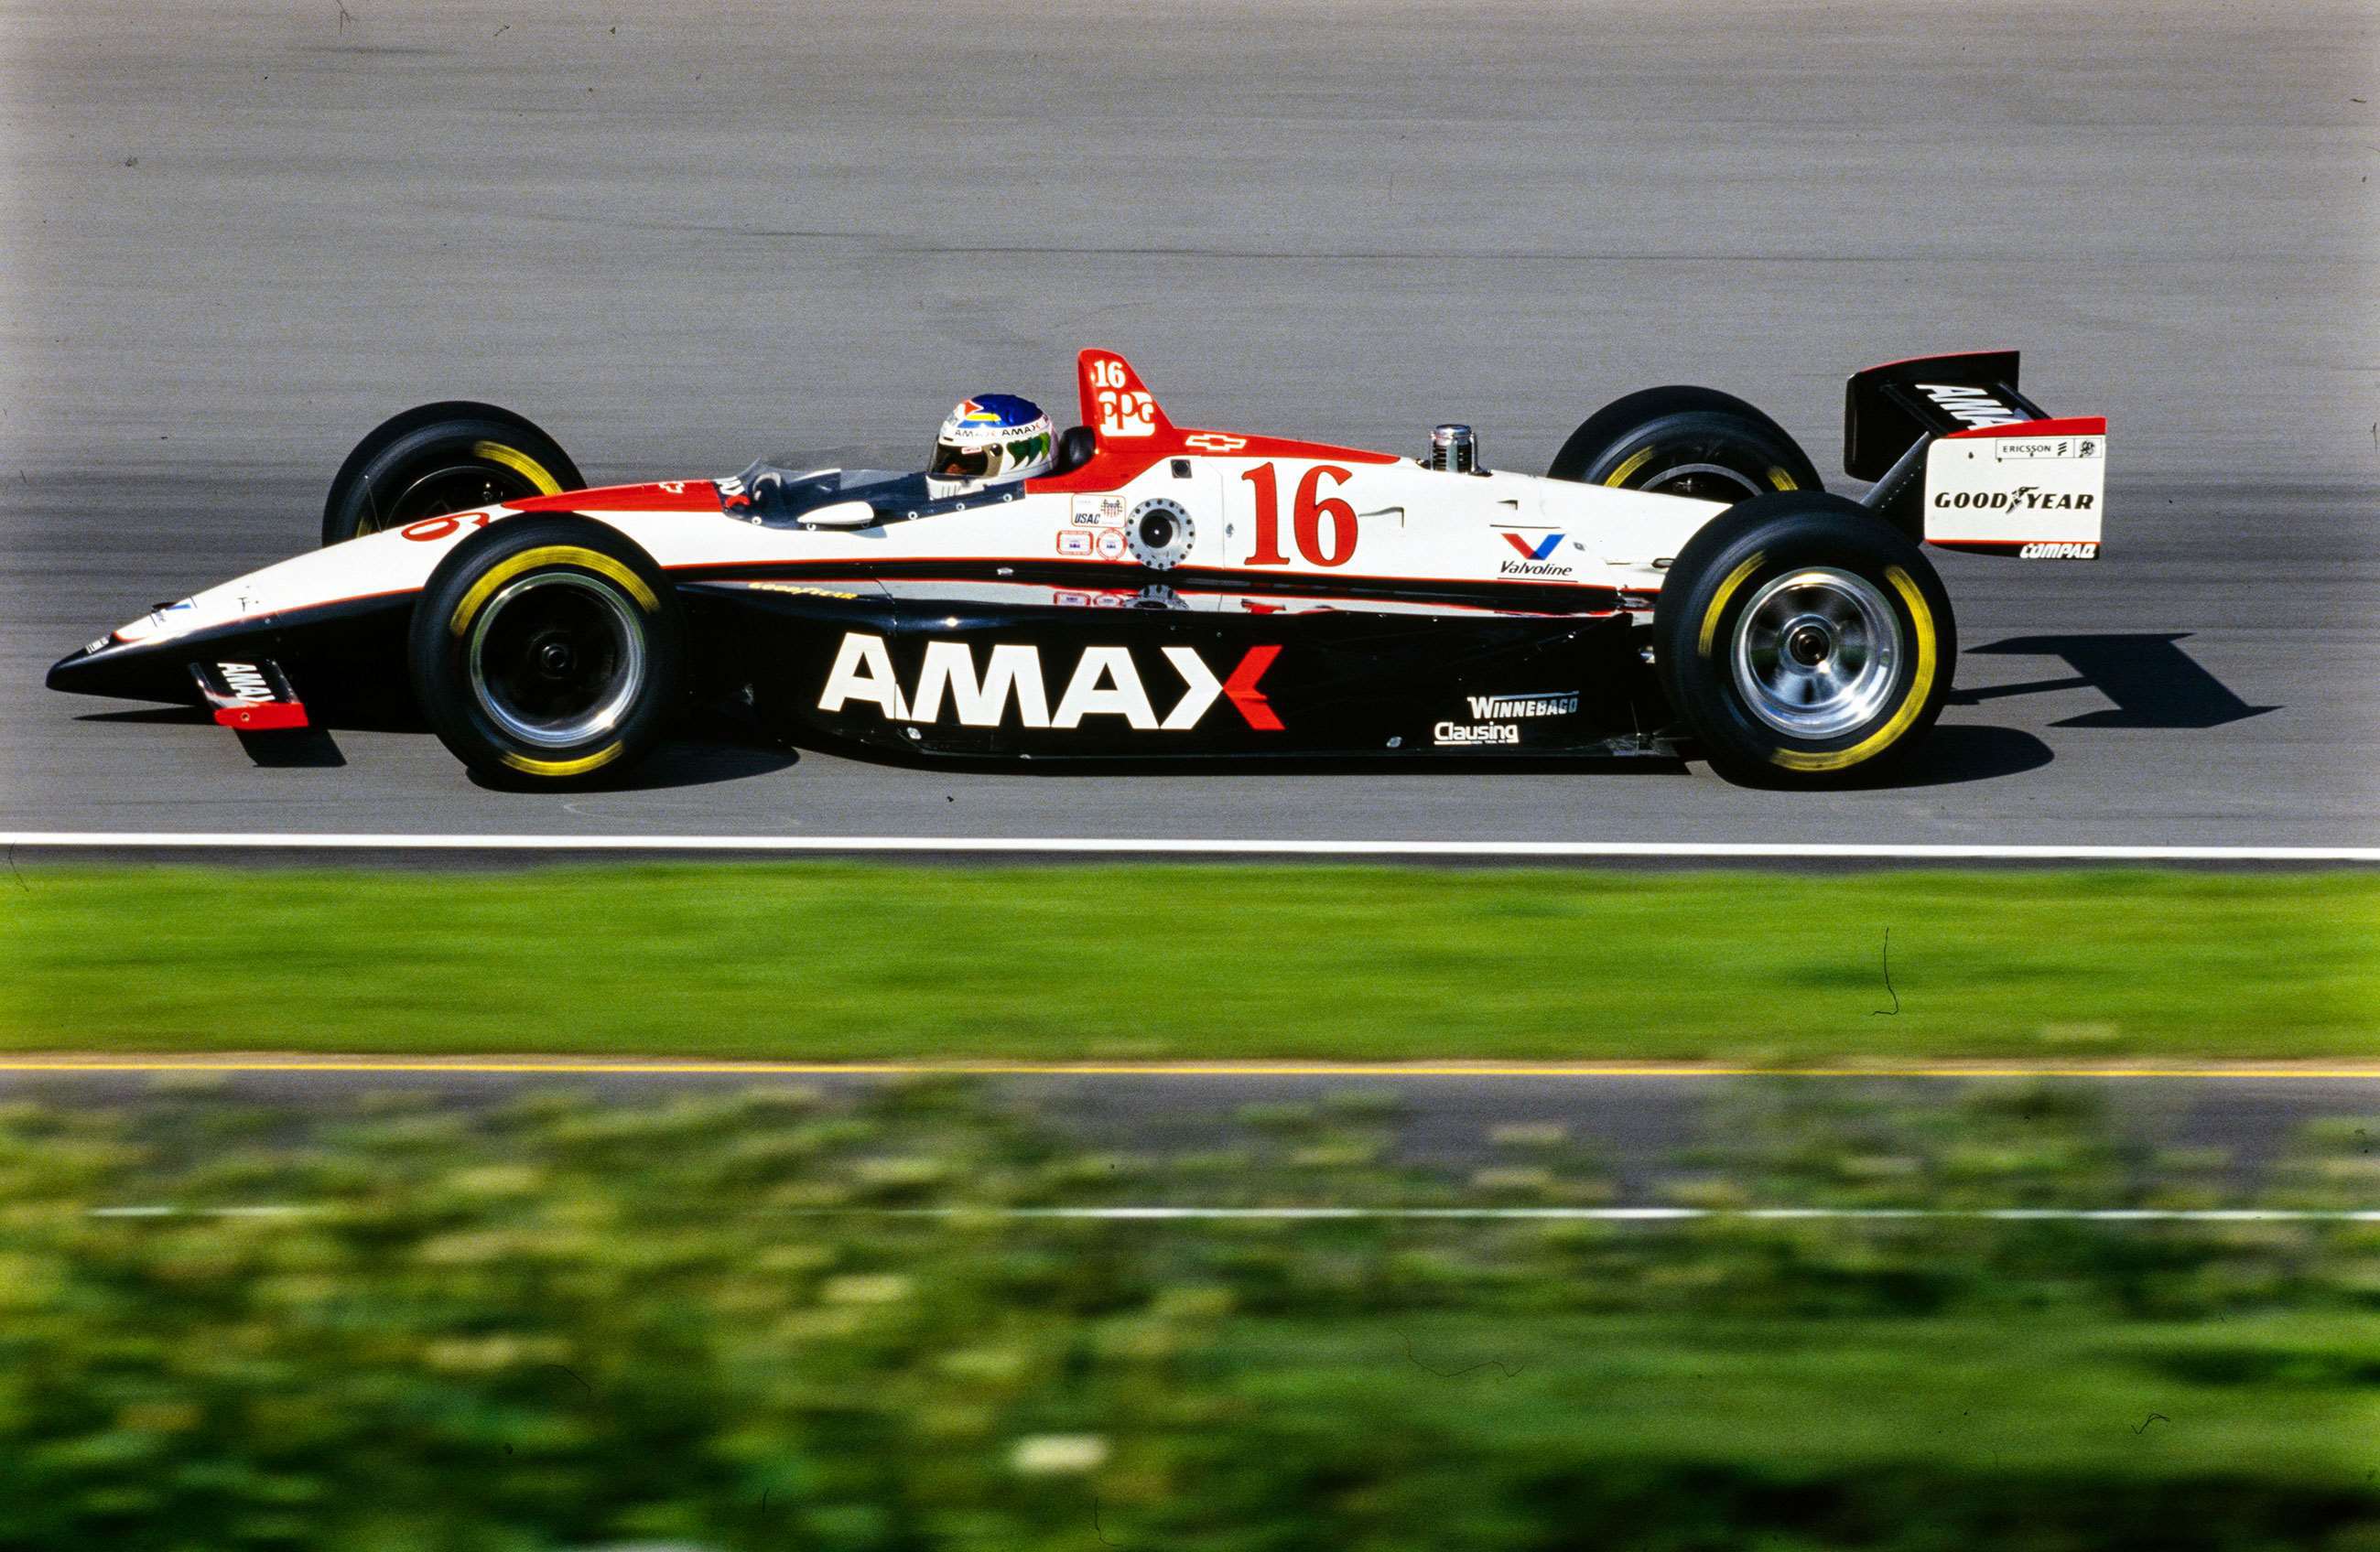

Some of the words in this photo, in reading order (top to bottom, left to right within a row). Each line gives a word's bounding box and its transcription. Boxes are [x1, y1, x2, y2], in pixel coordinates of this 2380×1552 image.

[1093, 360, 1126, 389] 16
[1914, 383, 2025, 431] AMA
[2002, 444, 2051, 453] ERICSSON
[1075, 512, 1100, 524] USAC
[1241, 461, 1358, 567] 16
[2019, 543, 2096, 559] COMPAQ
[1499, 560, 1573, 577] Valvoline
[817, 631, 1286, 731] AMAX
[1466, 695, 1579, 720] WINNEBAGO
[1433, 721, 1520, 743] Clausing
